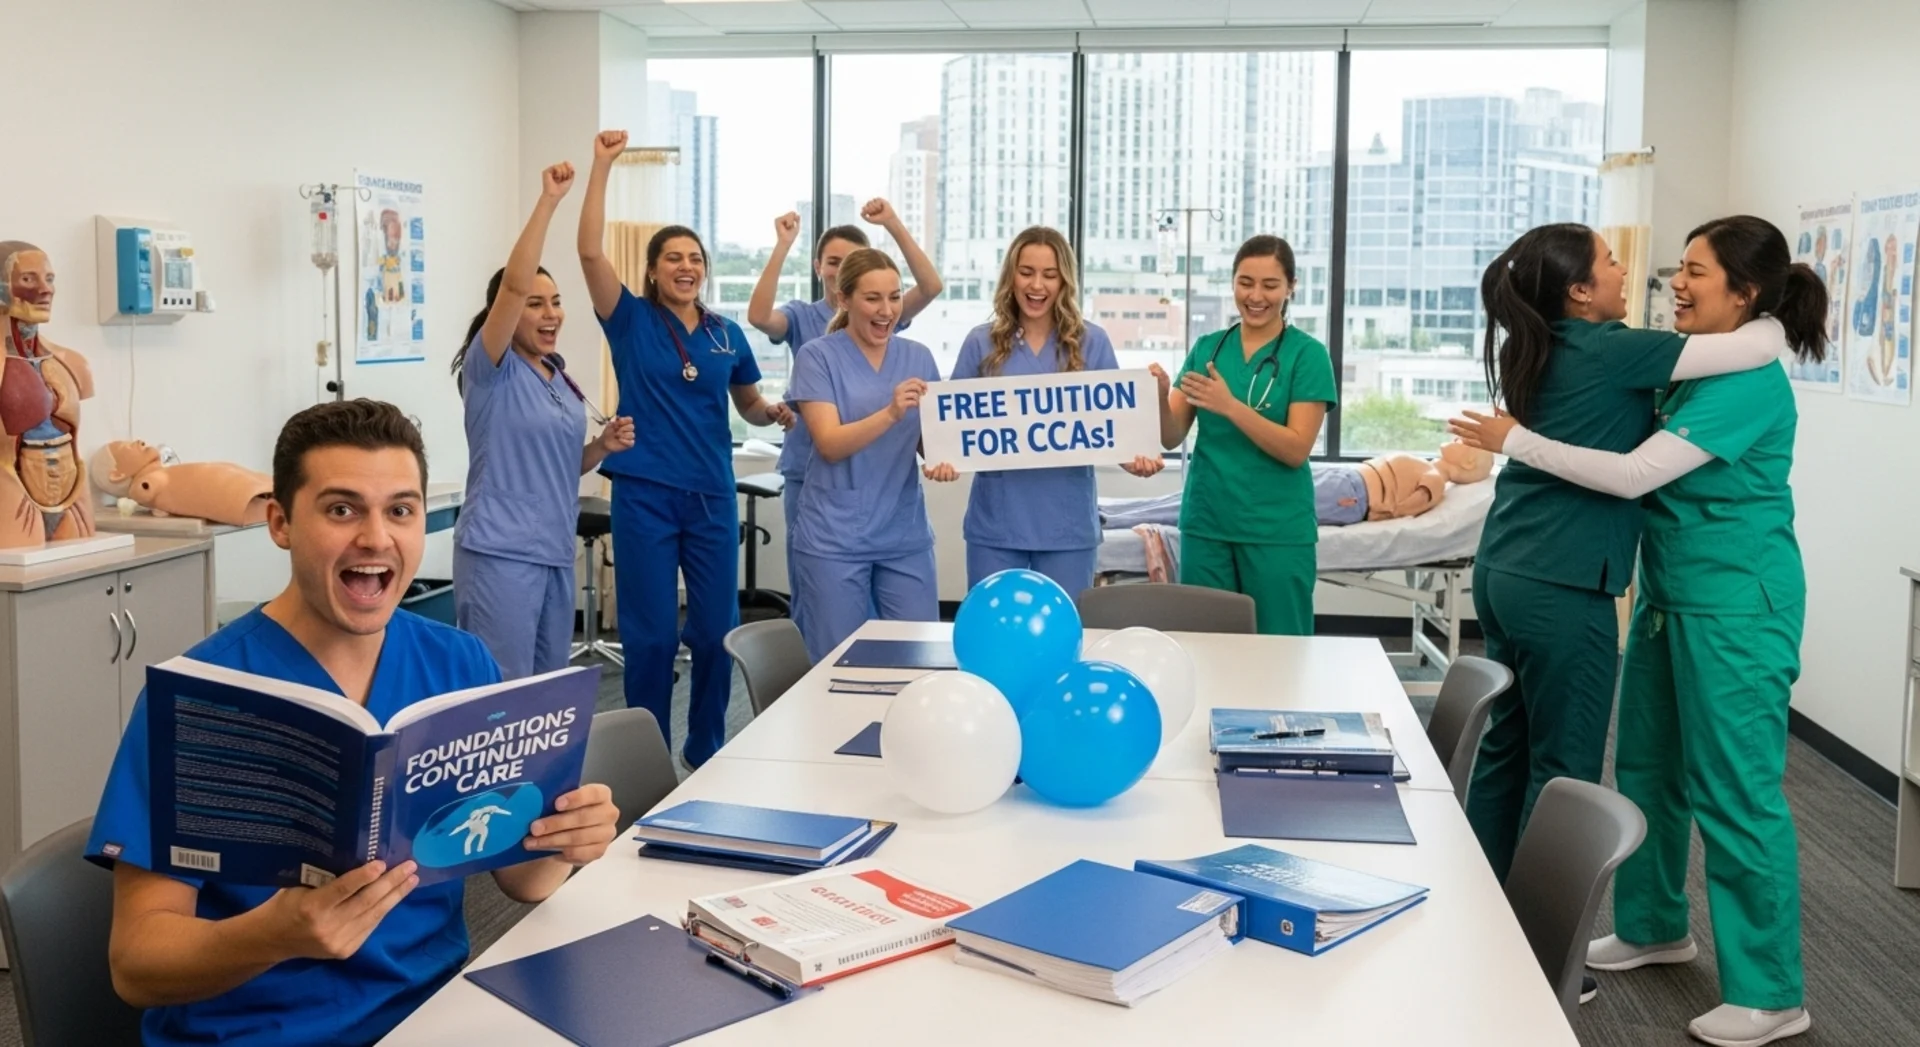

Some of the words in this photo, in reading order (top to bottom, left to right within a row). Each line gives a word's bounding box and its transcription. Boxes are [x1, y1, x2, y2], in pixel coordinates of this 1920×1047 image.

[938, 390, 1008, 421] FREE
[1014, 381, 1136, 415] TUITION
[961, 428, 1020, 457] FOR
[1027, 419, 1115, 452] CCAs!
[404, 727, 569, 795] CONTINUING
[405, 706, 576, 776] FOUNDATIONS
[455, 759, 524, 793] CARE
